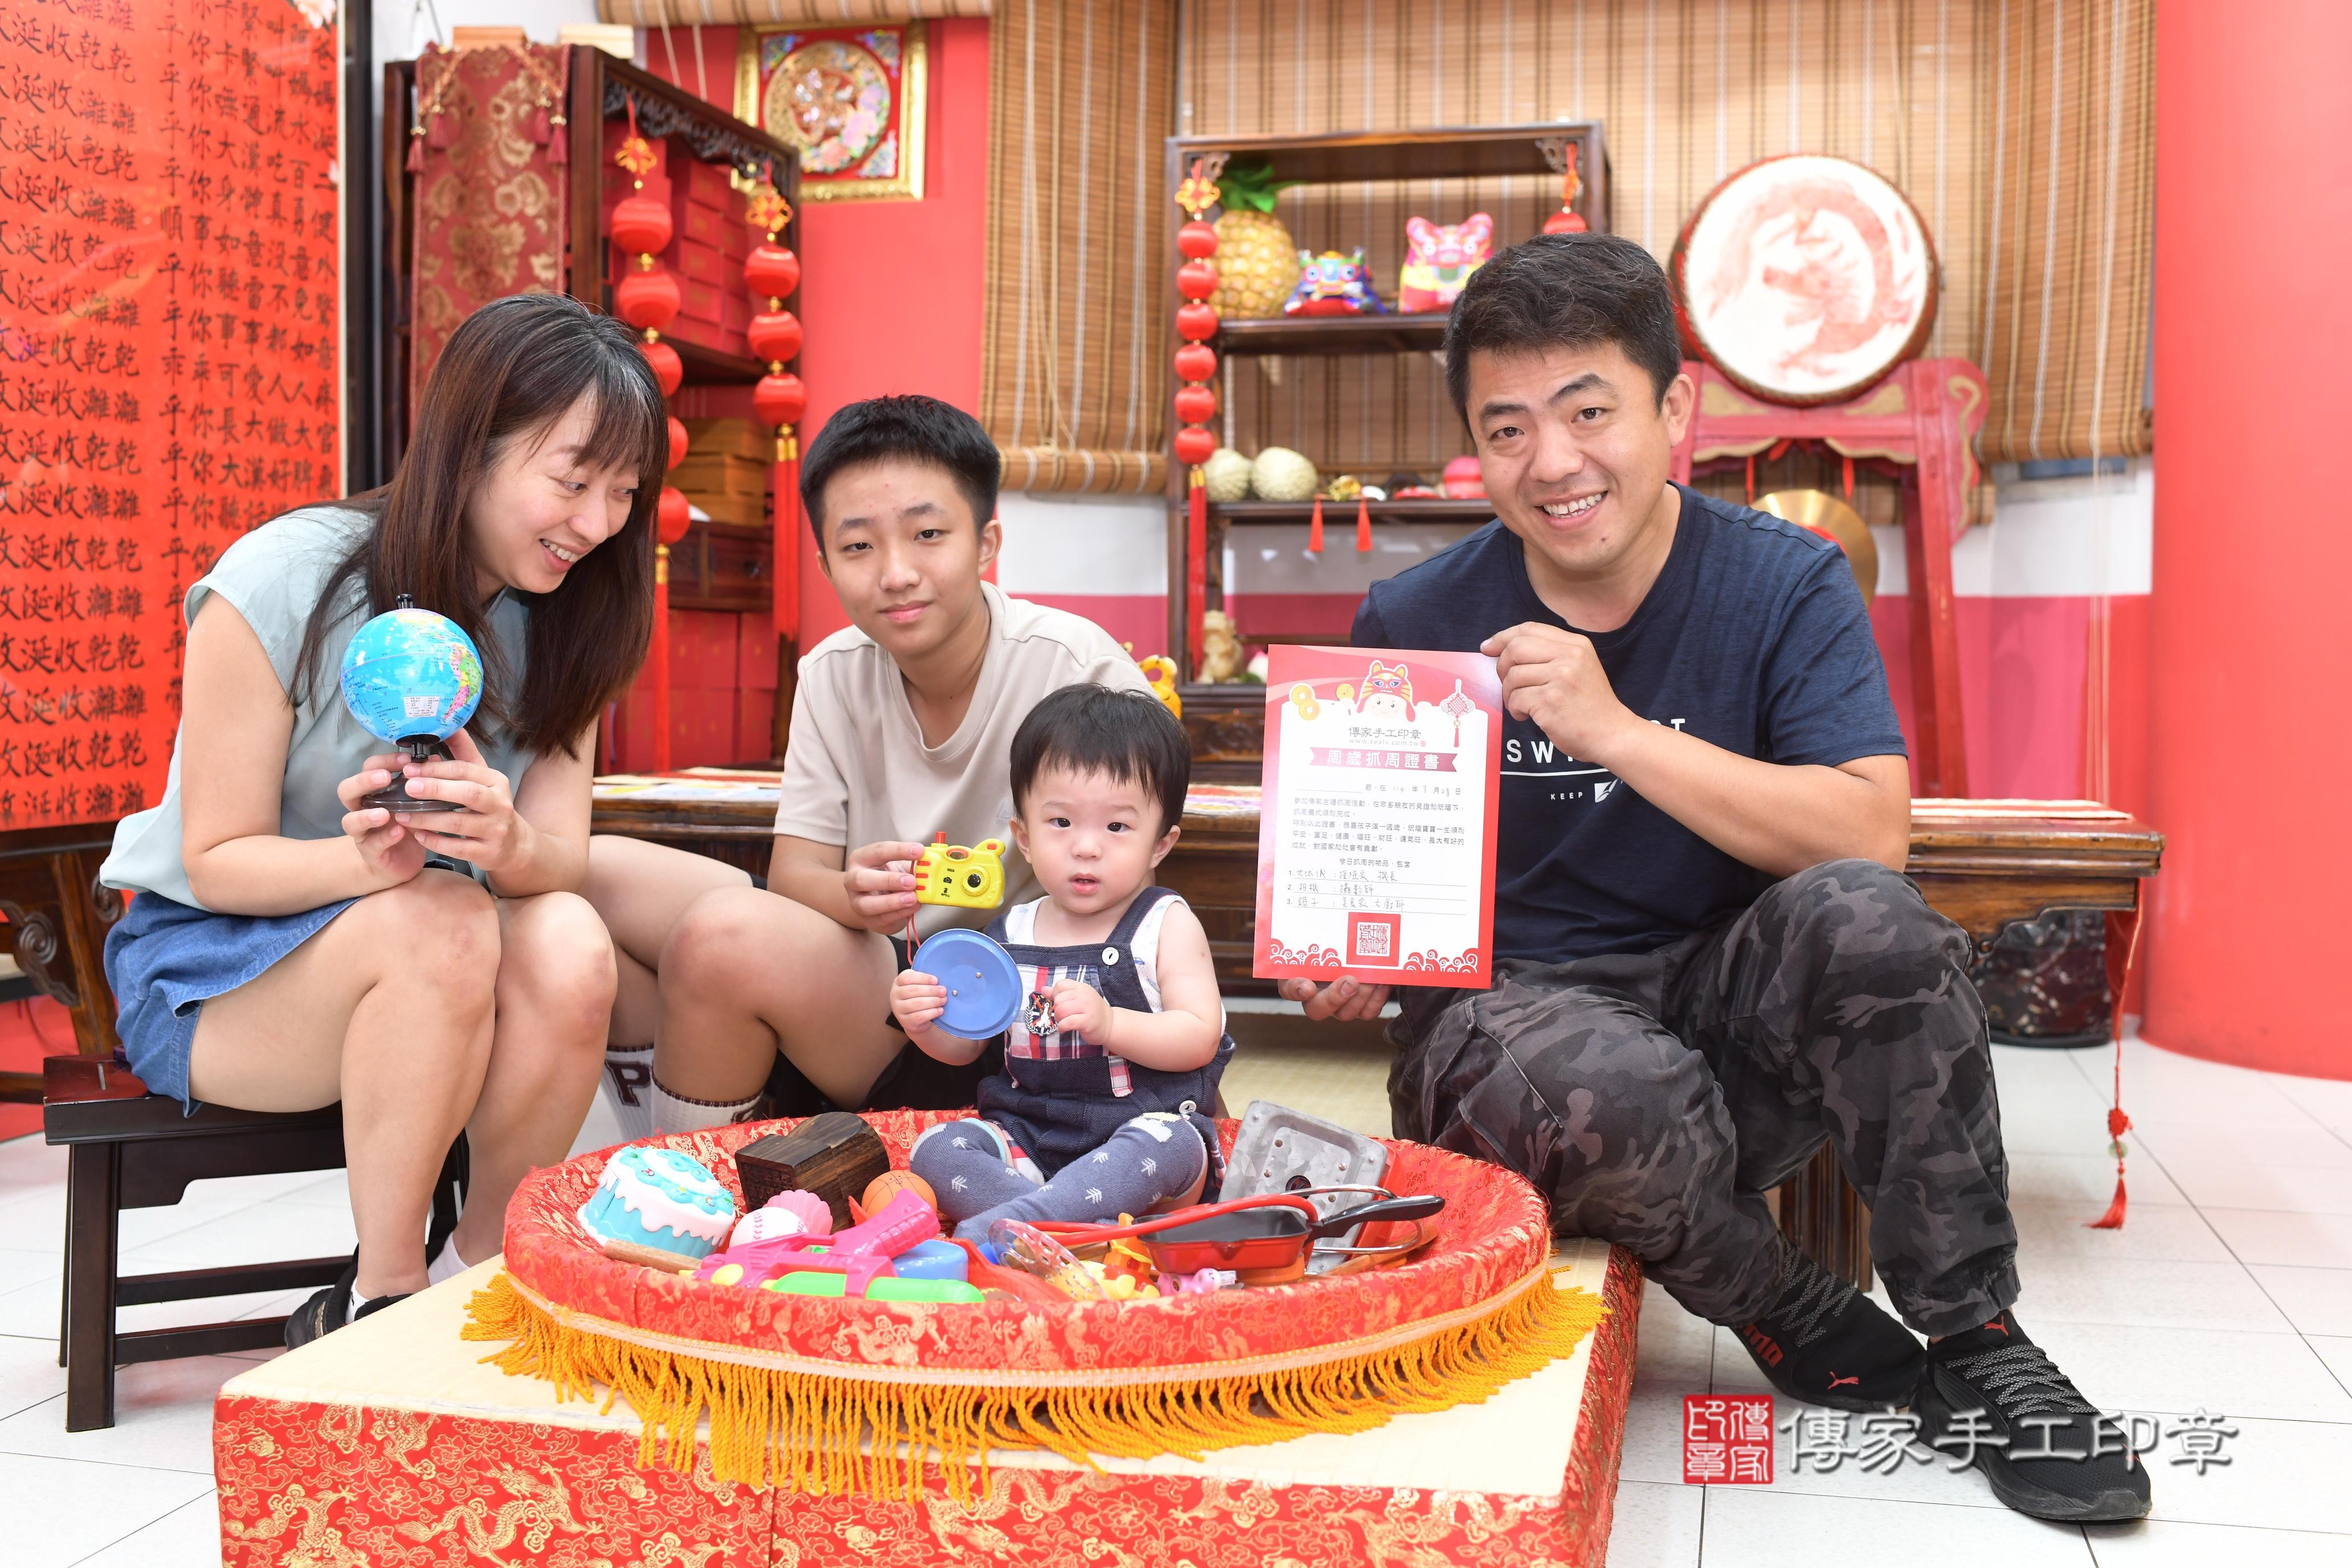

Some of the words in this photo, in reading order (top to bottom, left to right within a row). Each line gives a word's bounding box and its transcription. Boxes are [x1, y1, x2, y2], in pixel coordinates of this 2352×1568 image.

[1348, 726, 1421, 740] 傳家手工印章
[1327, 750, 1439, 769] 周歲抓周證書
[1551, 791, 1583, 800] KEEP
